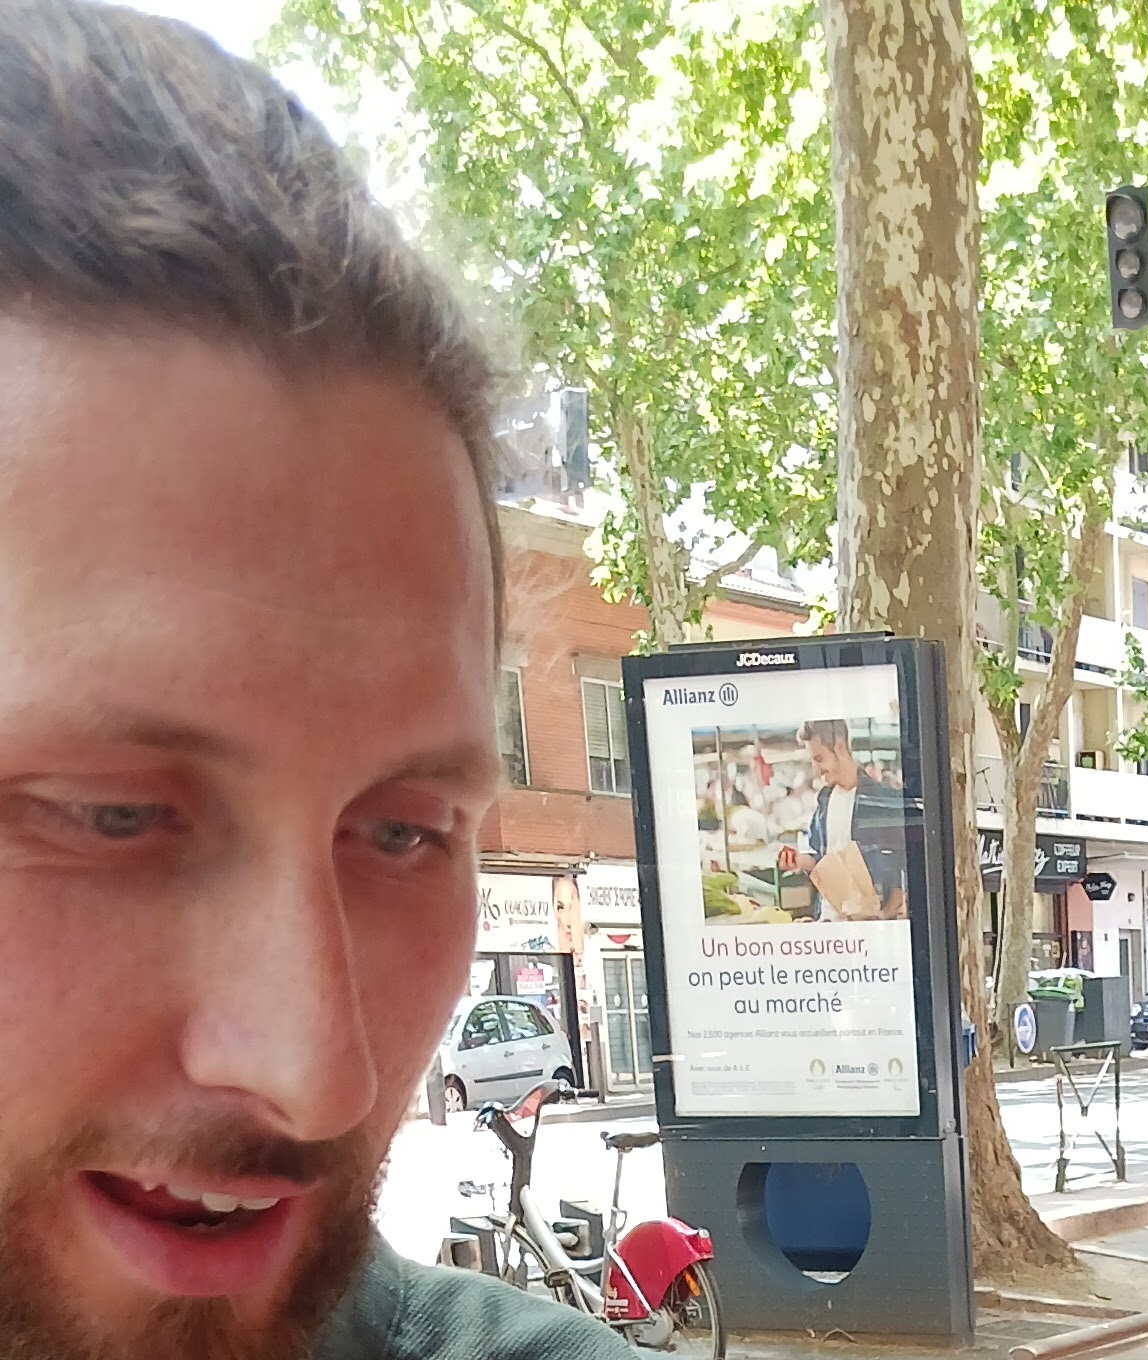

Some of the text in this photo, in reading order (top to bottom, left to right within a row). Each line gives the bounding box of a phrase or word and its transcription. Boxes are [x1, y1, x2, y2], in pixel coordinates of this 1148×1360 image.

[736, 653, 795, 667] JCDecaux
[663, 688, 716, 706] Allianz
[701, 936, 869, 957] Un bon assureur,
[688, 964, 899, 990] on peut le rencontrer
[734, 992, 843, 1014] au marché
